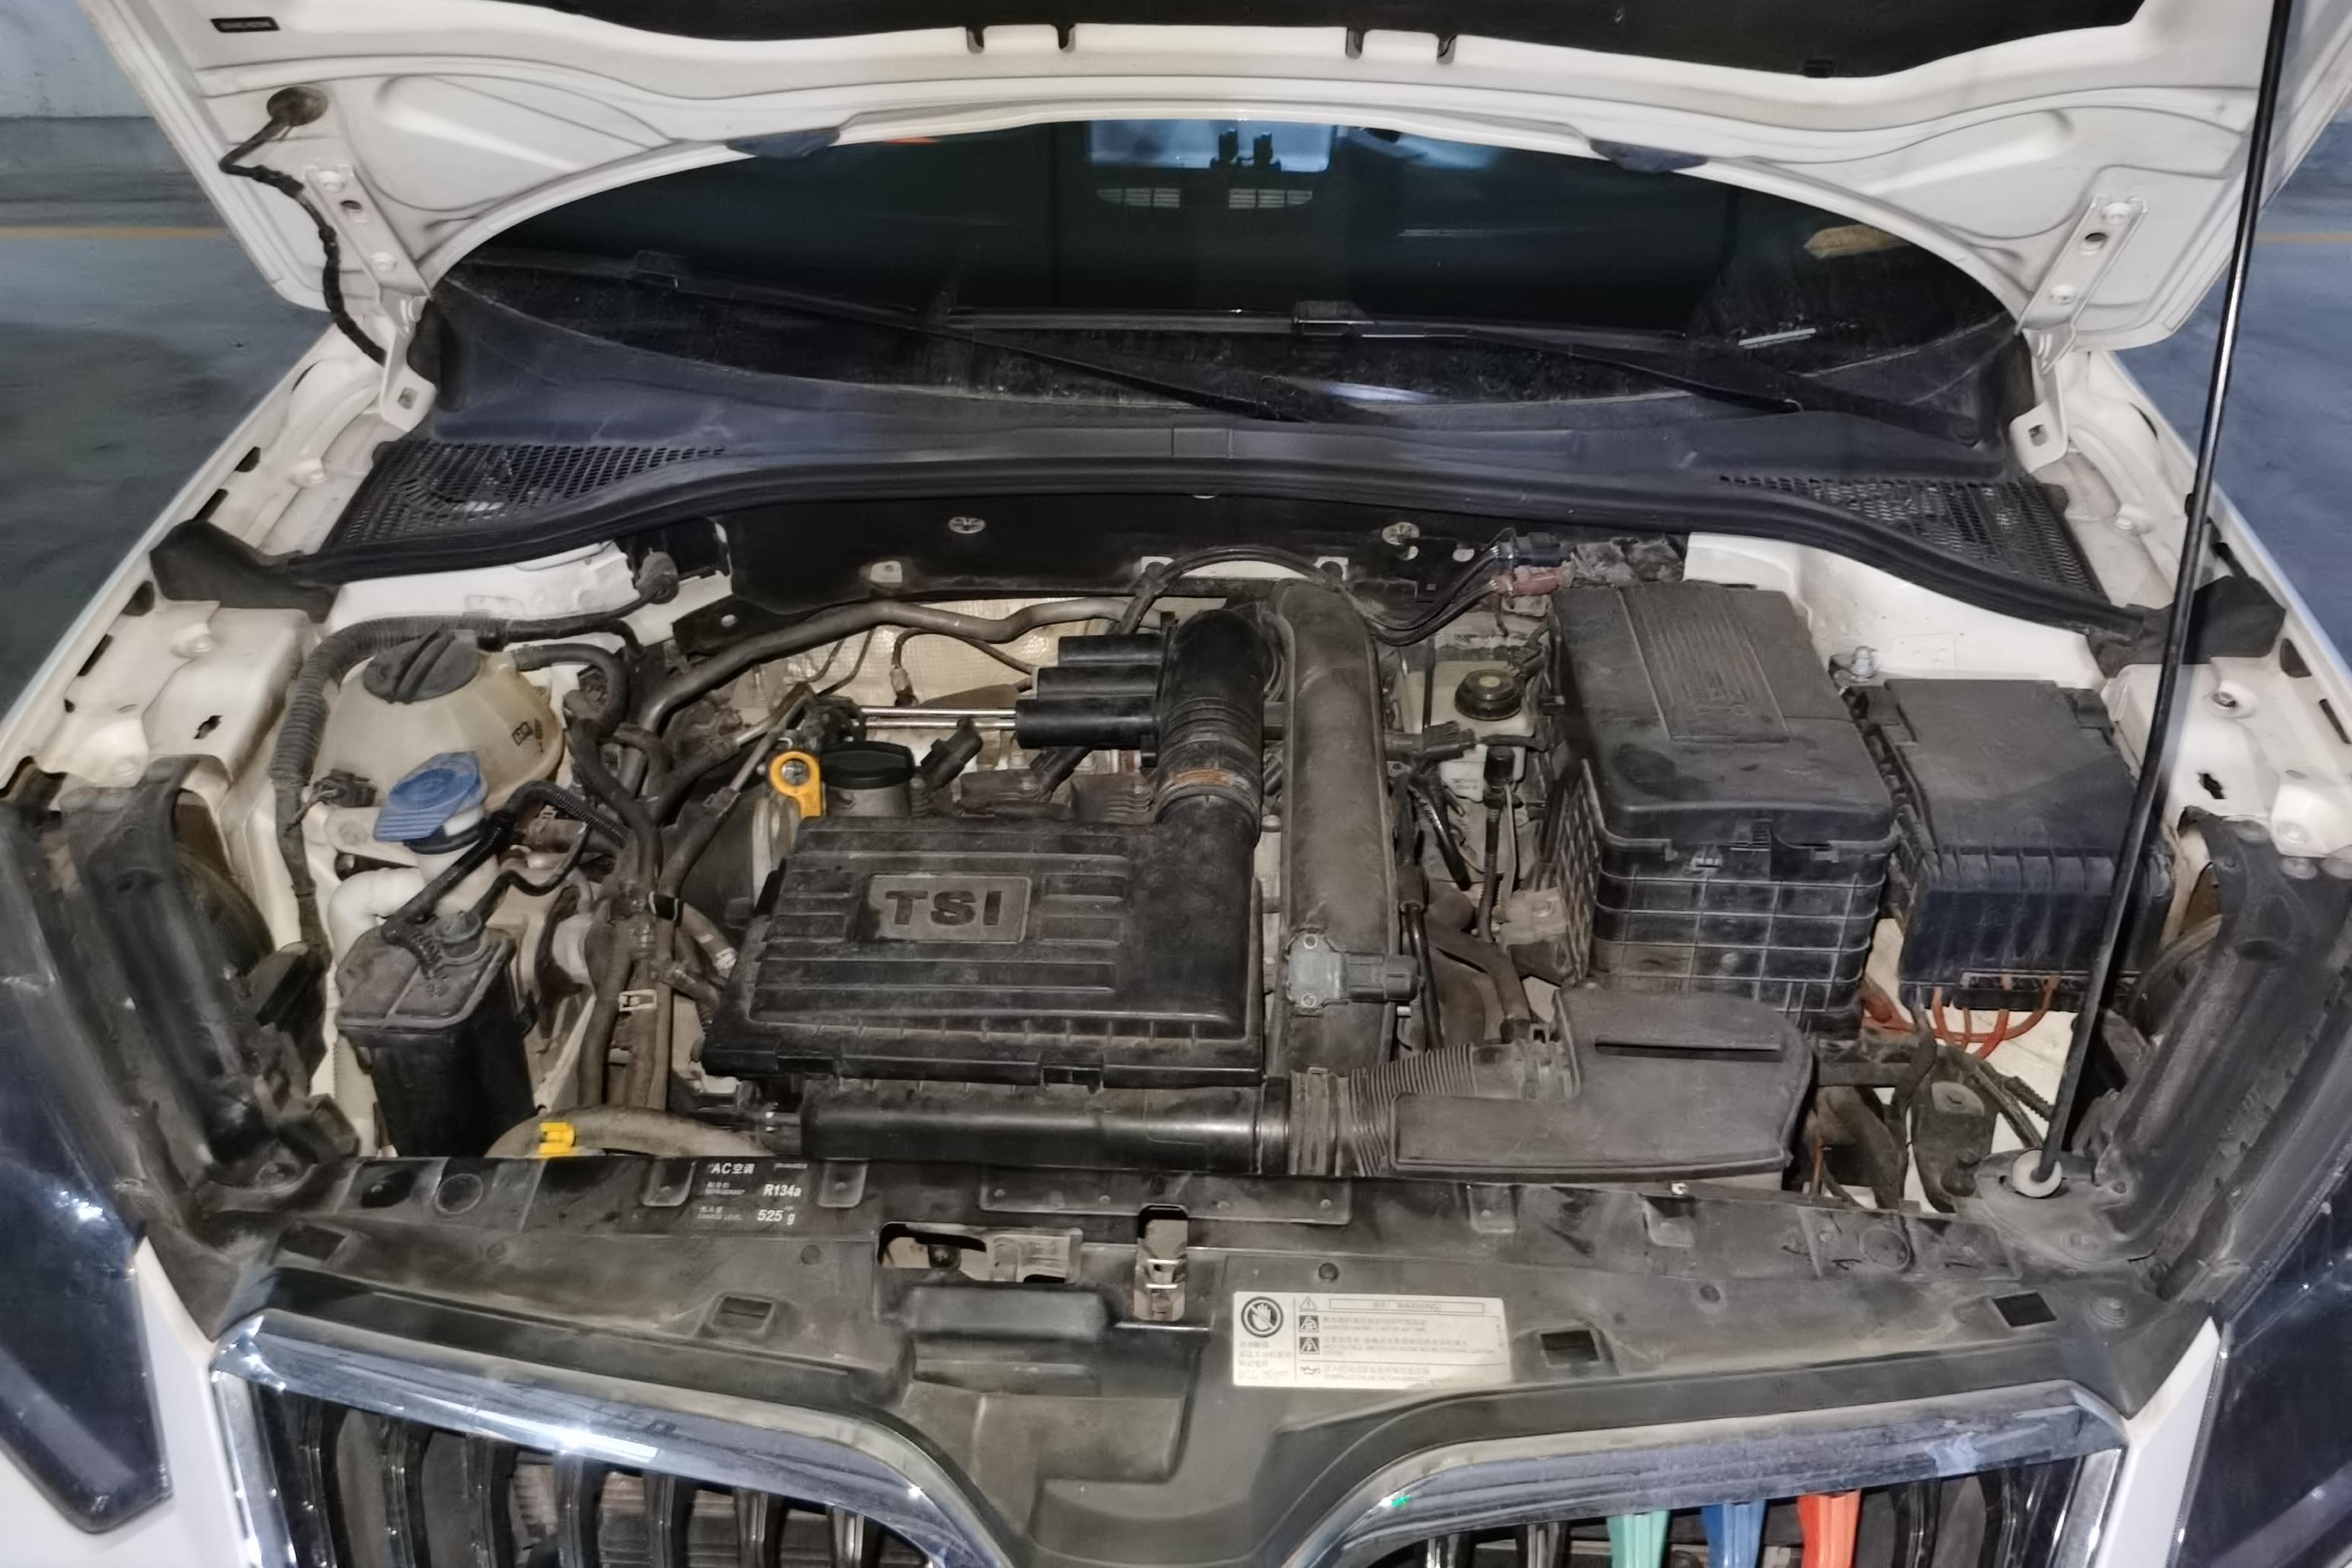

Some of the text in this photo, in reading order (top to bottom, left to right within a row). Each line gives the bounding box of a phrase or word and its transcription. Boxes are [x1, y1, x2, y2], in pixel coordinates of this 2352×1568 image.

[885, 890, 1002, 925] TSI
[764, 1183, 801, 1197] R134a
[756, 1209, 796, 1225] 525 g
